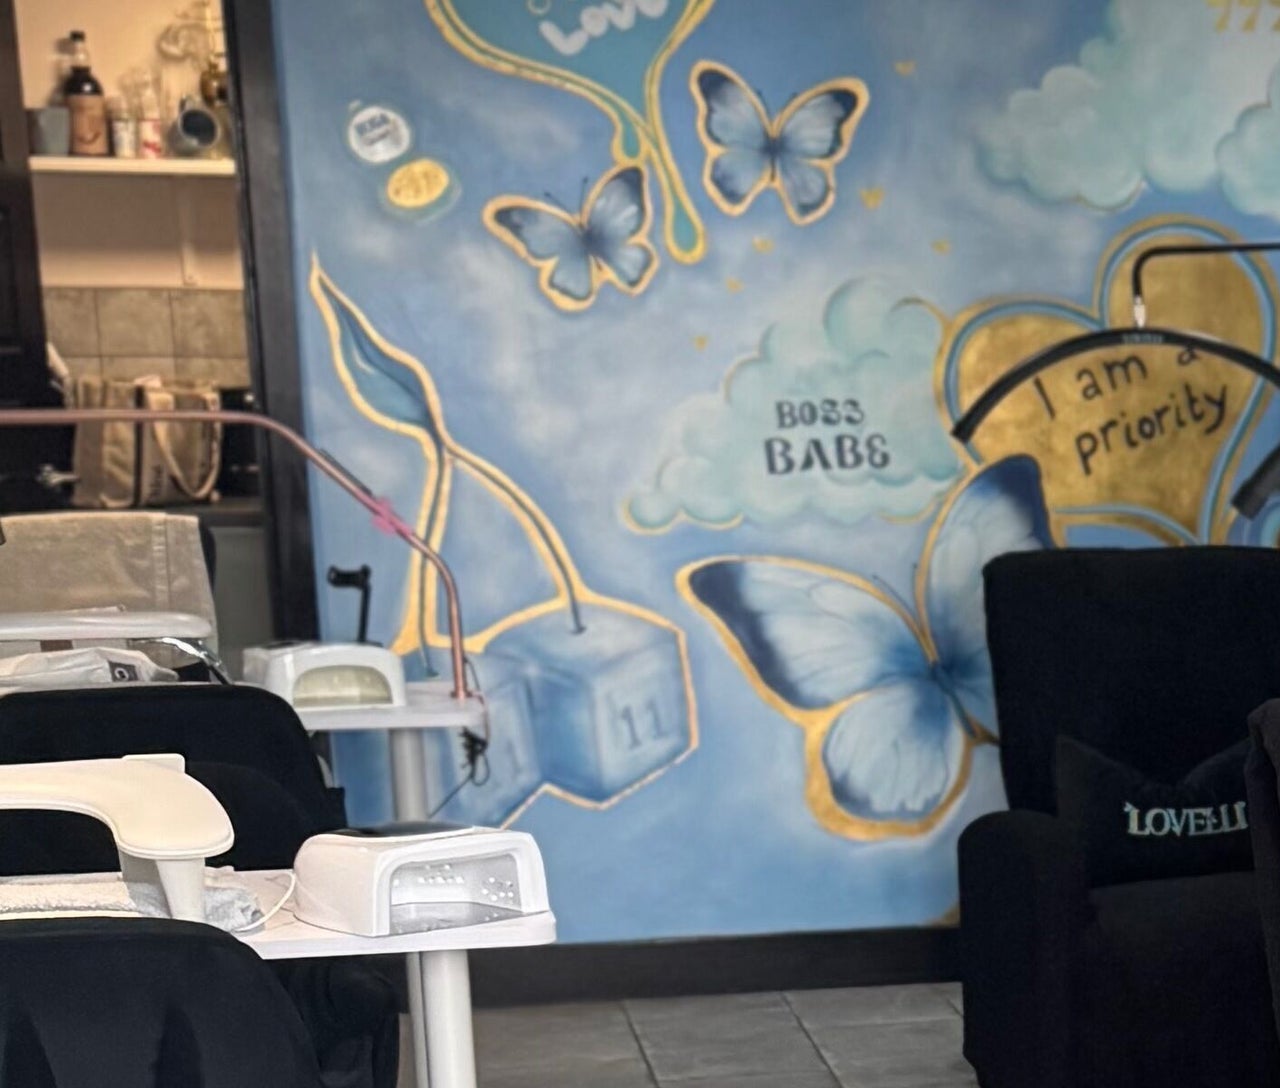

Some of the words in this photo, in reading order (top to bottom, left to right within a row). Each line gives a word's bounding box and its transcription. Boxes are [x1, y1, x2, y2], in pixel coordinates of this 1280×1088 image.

[1033, 376, 1056, 421] I
[1075, 354, 1149, 402] am
[775, 398, 866, 429] BOSS
[1074, 382, 1227, 477] priority
[764, 432, 891, 476] BABE
[1123, 801, 1249, 837] LOVELLI
